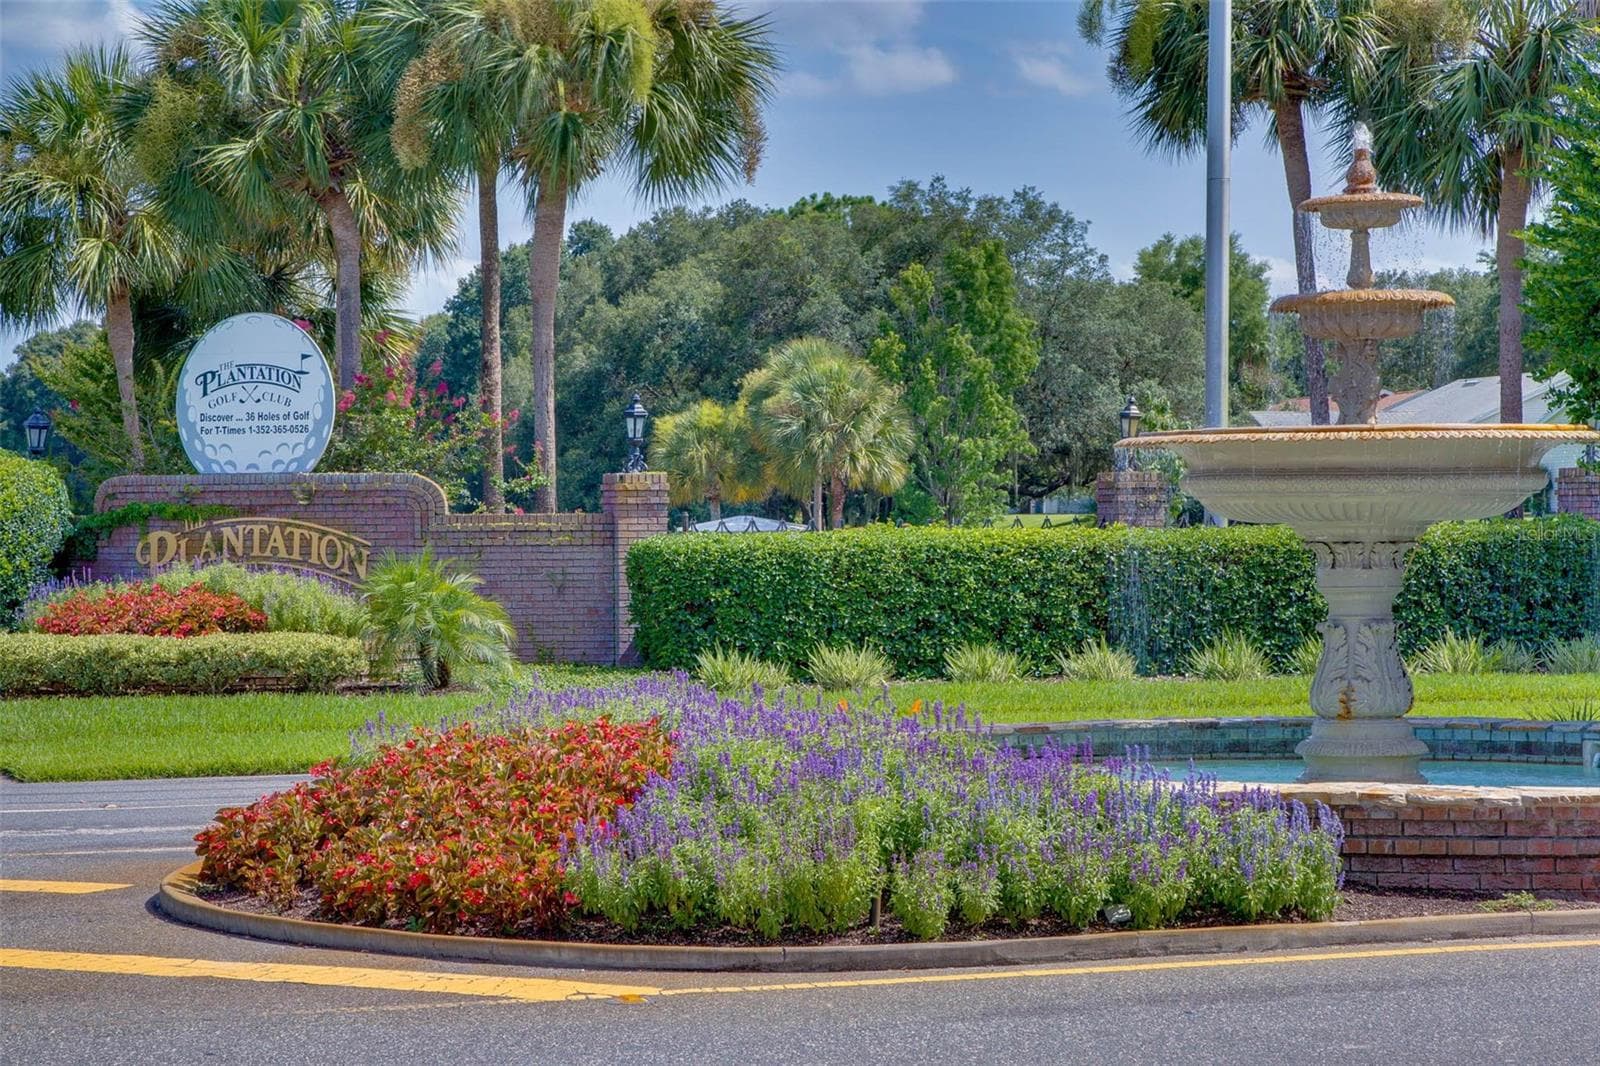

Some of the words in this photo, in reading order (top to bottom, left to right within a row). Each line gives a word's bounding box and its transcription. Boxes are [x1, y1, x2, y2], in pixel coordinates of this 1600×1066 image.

[219, 360, 235, 372] THE
[195, 366, 302, 399] PLANTATION
[208, 391, 238, 409] GOLF
[261, 391, 292, 408] CLUB
[200, 413, 234, 423] Discover
[245, 412, 257, 421] 36
[257, 411, 281, 421] Holes
[282, 411, 291, 421] of
[292, 410, 310, 421] Golf
[200, 426, 213, 436] For
[215, 425, 246, 435] T-Times
[248, 425, 310, 434] 1-352-365-0526
[135, 525, 370, 581] PLANTATION
